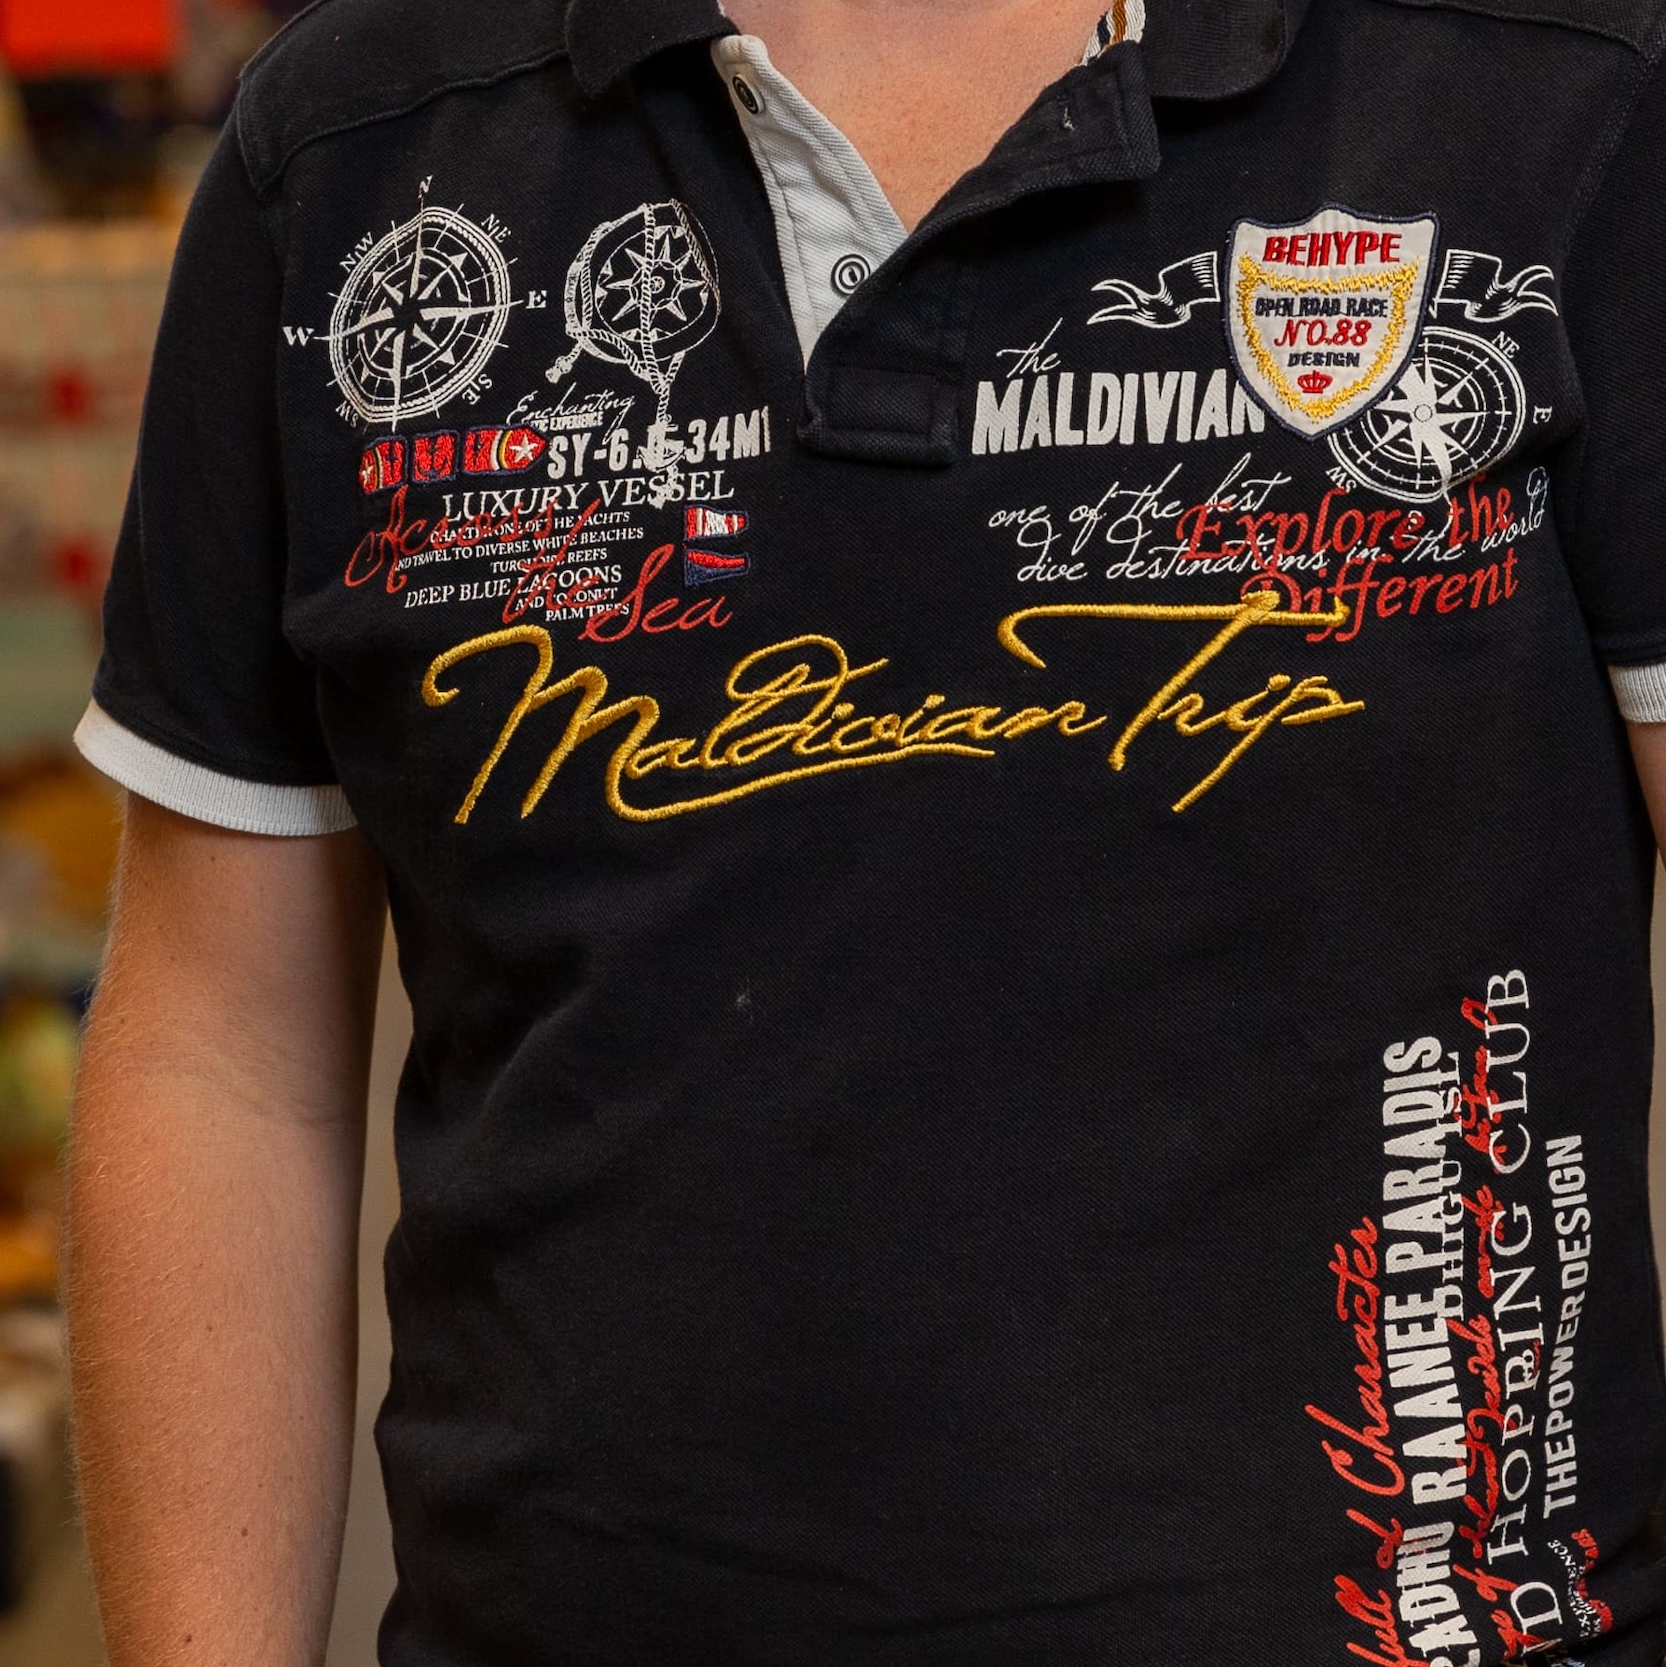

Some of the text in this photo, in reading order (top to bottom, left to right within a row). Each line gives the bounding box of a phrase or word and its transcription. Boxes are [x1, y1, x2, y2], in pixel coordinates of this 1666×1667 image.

[1262, 231, 1402, 267] BEHYPE
[283, 326, 314, 347] W
[1255, 297, 1388, 318] OPEN ROAD RACE
[995, 317, 1063, 379] the
[1287, 352, 1360, 367] DESIGN
[506, 382, 635, 445] Enchanting
[971, 368, 1265, 455] MALDIVIAN
[442, 470, 735, 522] LUXURY VESSEL
[1176, 474, 1515, 573] Explore the
[454, 546, 473, 560] TO
[475, 540, 531, 557] DIVERSE
[581, 527, 644, 545] BEACHES
[567, 548, 608, 565] REEFS
[404, 584, 456, 609] DEEP
[459, 578, 511, 601] BLUE
[578, 543, 733, 643] Sea
[997, 588, 1364, 812] Trip
[1484, 968, 1532, 1175] CLUB
[1383, 1035, 1442, 1278] PARADIS
[1305, 1215, 1405, 1498] Character
[1384, 1291, 1470, 1506] RAANEE
